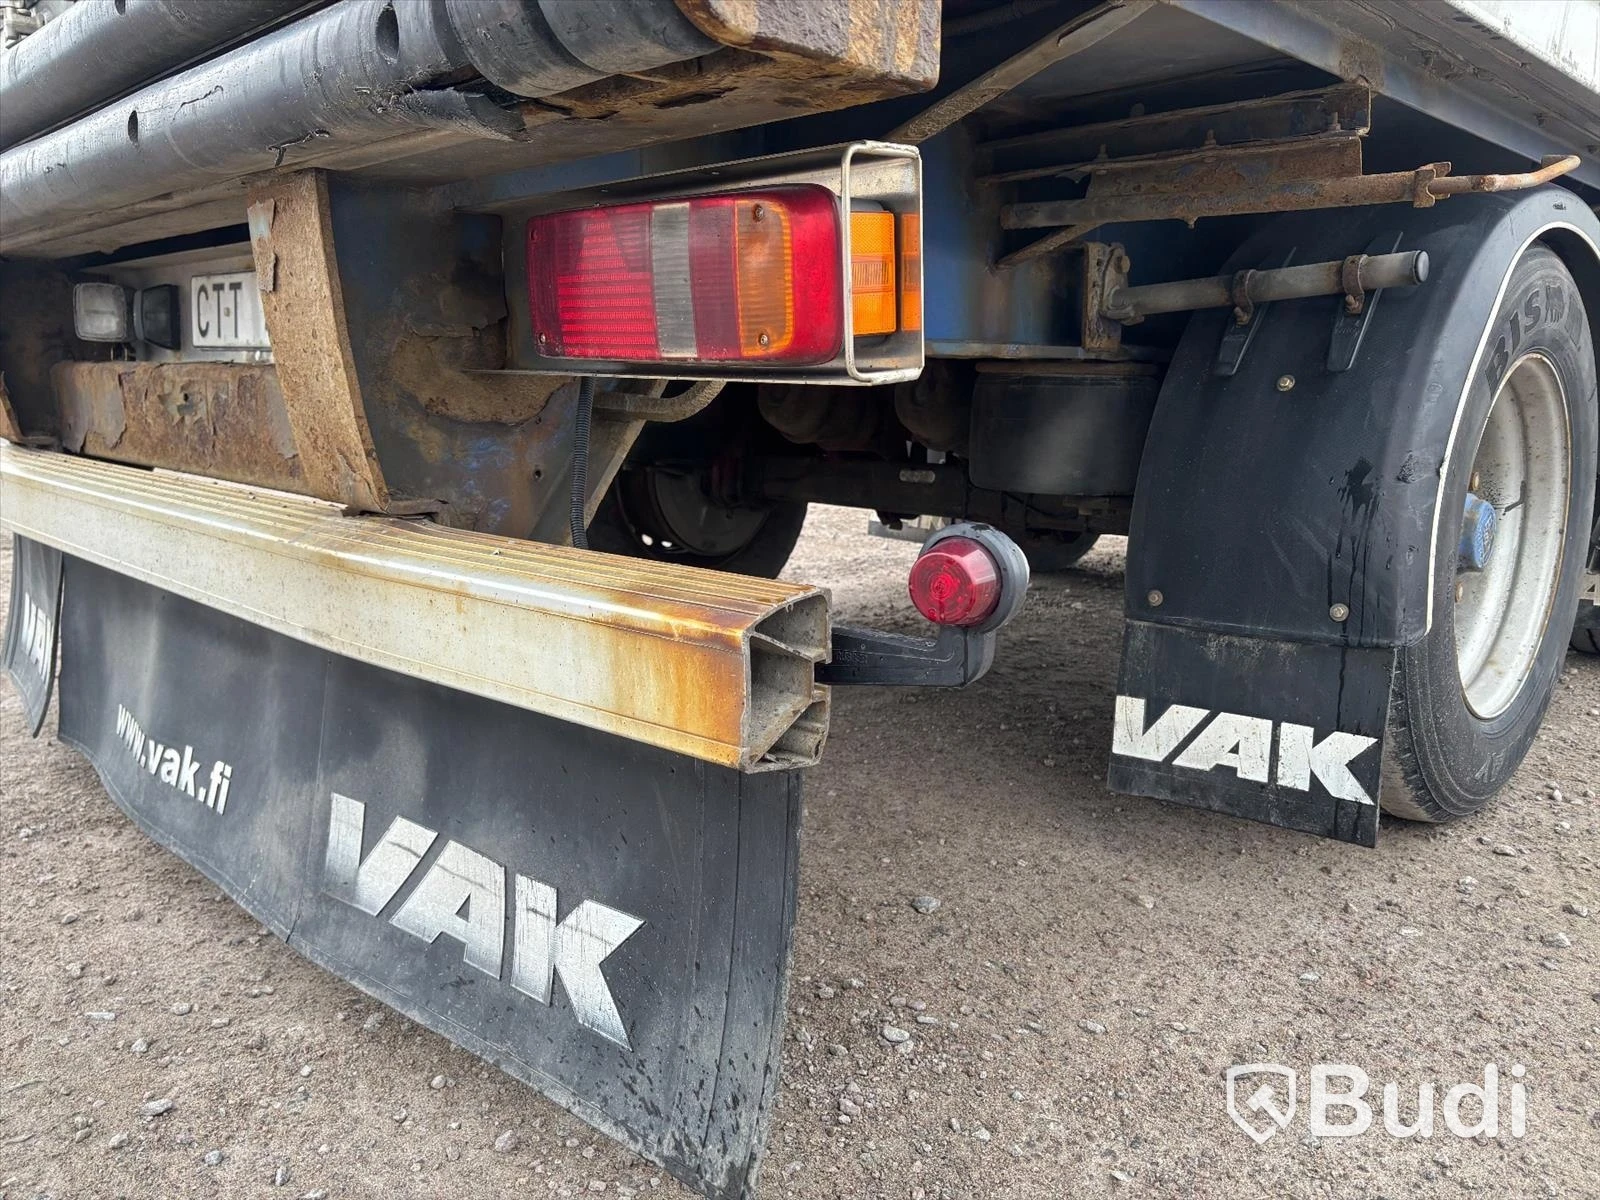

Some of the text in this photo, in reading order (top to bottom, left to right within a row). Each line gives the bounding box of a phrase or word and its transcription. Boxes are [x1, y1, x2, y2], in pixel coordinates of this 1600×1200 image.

[197, 282, 242, 339] CTT
[116, 703, 233, 815] www.vak.fi
[1112, 695, 1378, 806] VAK
[326, 793, 645, 1051] VAK
